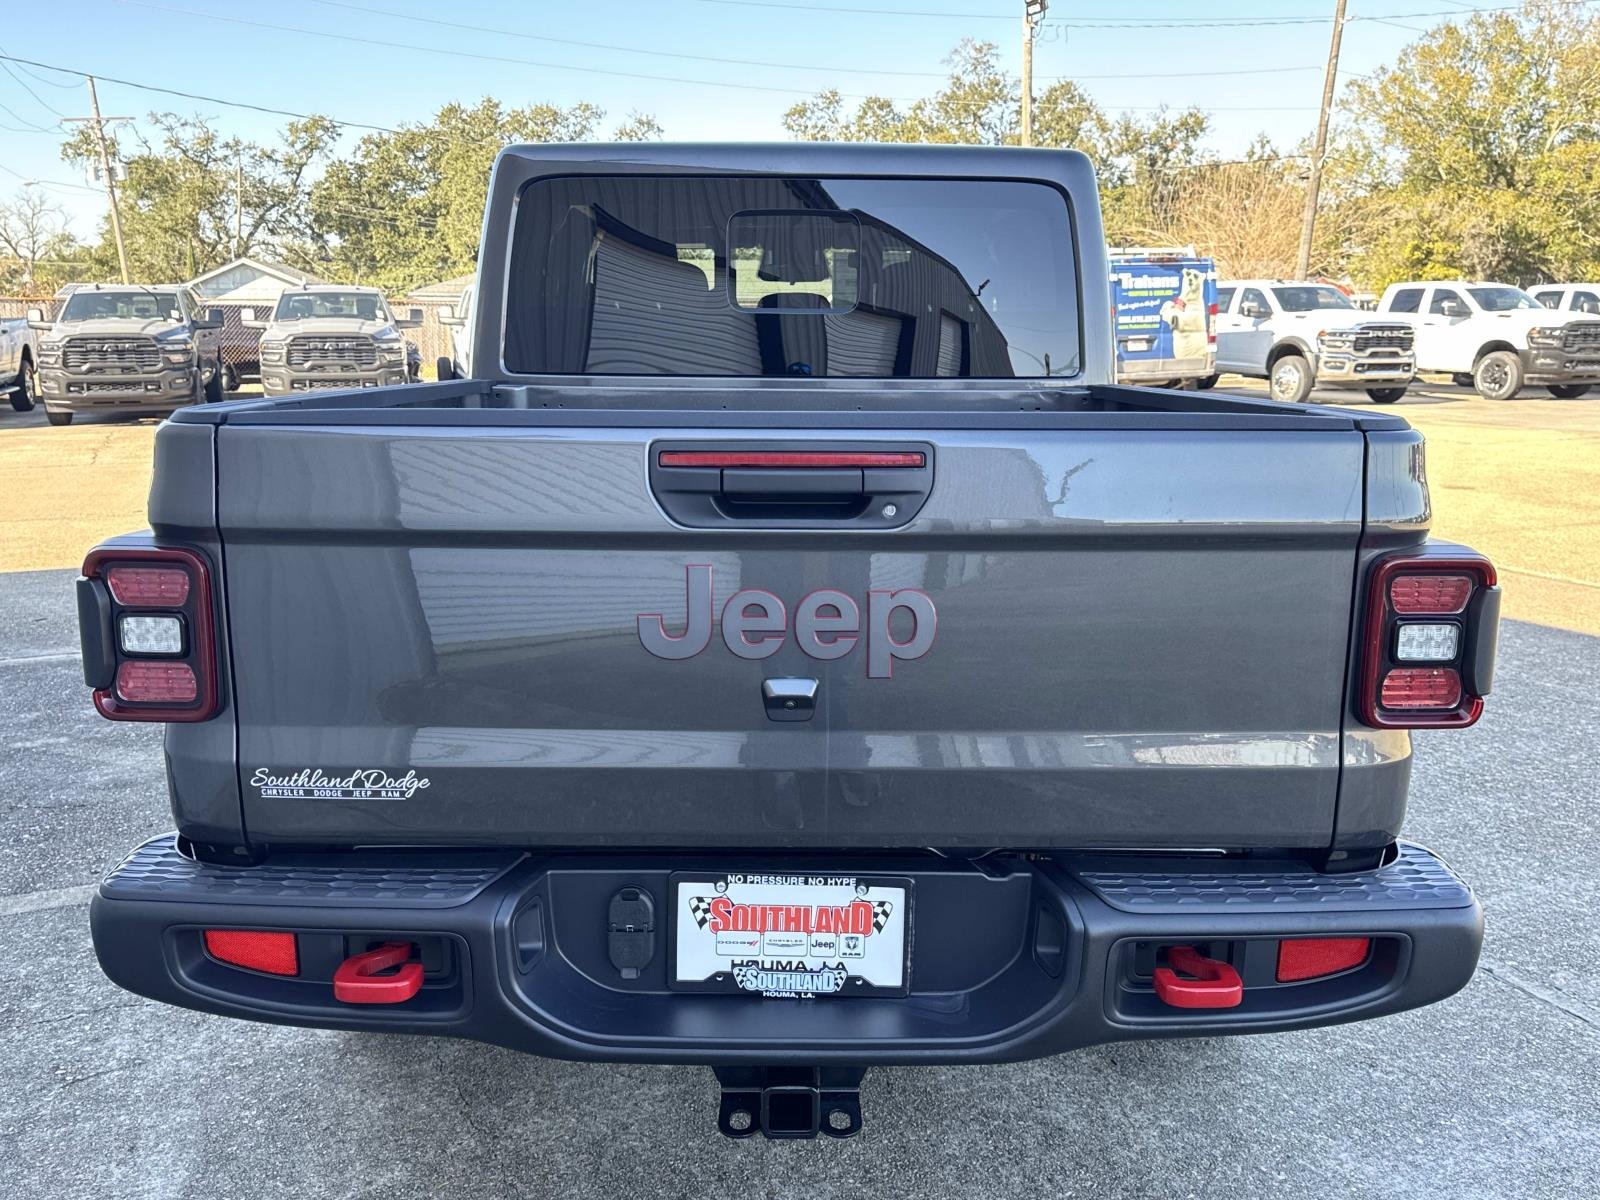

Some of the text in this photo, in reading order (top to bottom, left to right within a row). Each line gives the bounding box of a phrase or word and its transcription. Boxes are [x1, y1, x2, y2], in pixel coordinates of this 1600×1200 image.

[637, 564, 938, 680] Jeep
[250, 767, 431, 799] Southland Dodge
[261, 788, 400, 798] CHRYSLER DODGE JEEP RAM
[727, 874, 857, 888] NO PRESSURE NO HYPE
[709, 897, 874, 937] SOUTHLAND
[811, 940, 835, 950] Jeep
[744, 968, 836, 992] SOUTHLAND
[762, 991, 816, 999] HOUMA, LA.
